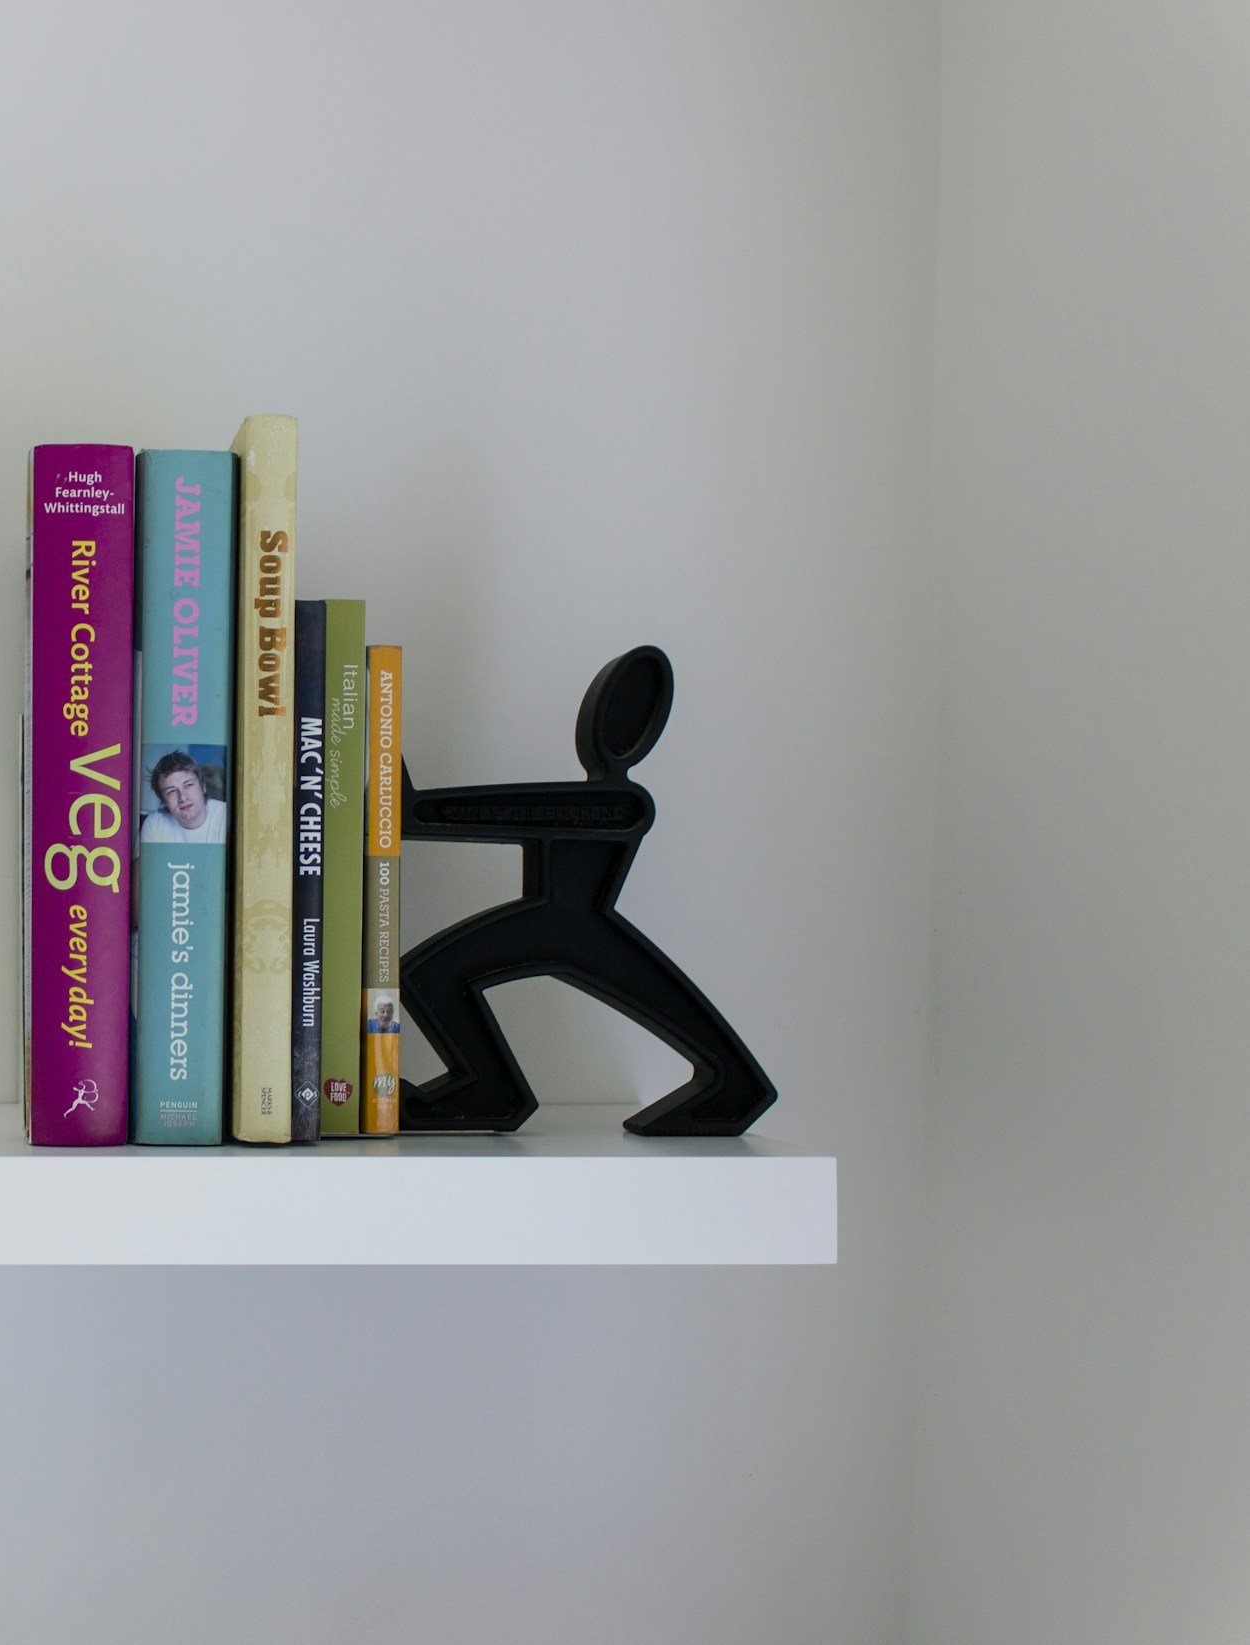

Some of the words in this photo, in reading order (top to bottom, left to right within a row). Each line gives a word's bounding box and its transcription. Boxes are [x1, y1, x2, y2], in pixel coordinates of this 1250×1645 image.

[44, 502, 125, 517] Whittingstall
[55, 487, 115, 501] Fearnley-
[68, 471, 102, 485] Hugh
[174, 476, 202, 588] JAMIE
[71, 540, 97, 615] River
[254, 530, 289, 618] Soup
[62, 623, 96, 737] Cottage
[171, 598, 200, 727] OLIVER
[258, 626, 288, 717] Bowl
[330, 697, 347, 746] made
[342, 664, 359, 729] Italian
[380, 670, 393, 749] ANTONIO
[300, 717, 323, 764] MAC
[324, 749, 348, 809] simple
[379, 752, 393, 849] CARLUCCIO
[44, 743, 122, 894] veg
[299, 802, 322, 876] CHEESE
[379, 861, 390, 887] 100
[167, 862, 195, 964] jamie's
[303, 918, 321, 956] Laura
[379, 889, 390, 928] PASTA
[379, 931, 390, 983] RECIPES
[302, 959, 321, 1028] Washburn
[169, 972, 194, 1081] dinners
[160, 1101, 198, 1110] PENGUIN
[330, 1081, 347, 1092] LOVE
[372, 1074, 396, 1095] my
